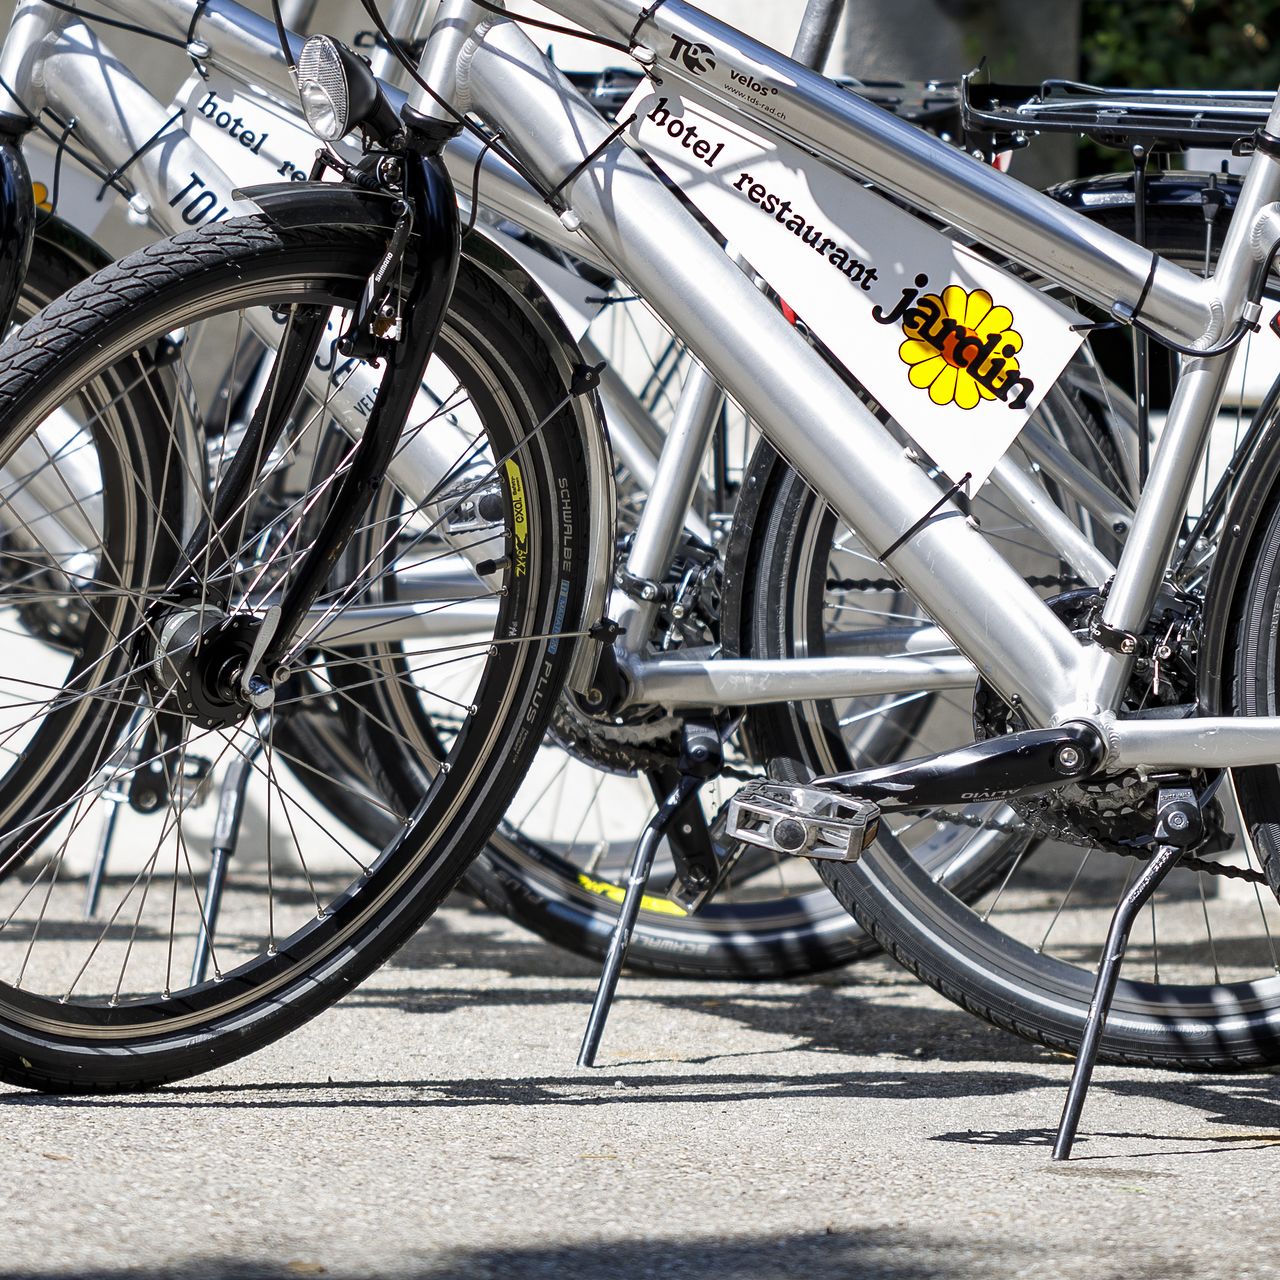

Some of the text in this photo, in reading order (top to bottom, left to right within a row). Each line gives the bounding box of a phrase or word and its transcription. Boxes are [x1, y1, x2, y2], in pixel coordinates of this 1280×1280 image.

[669, 33, 718, 76] TDS
[197, 91, 269, 155] hotel
[724, 82, 787, 120] www.tds-rad.ch
[646, 97, 879, 291] hotel restaurant
[374, 251, 394, 283] SHIMANO
[871, 273, 1035, 410] jardin
[557, 477, 574, 572] SCHWALBE
[526, 660, 553, 724] PLUS
